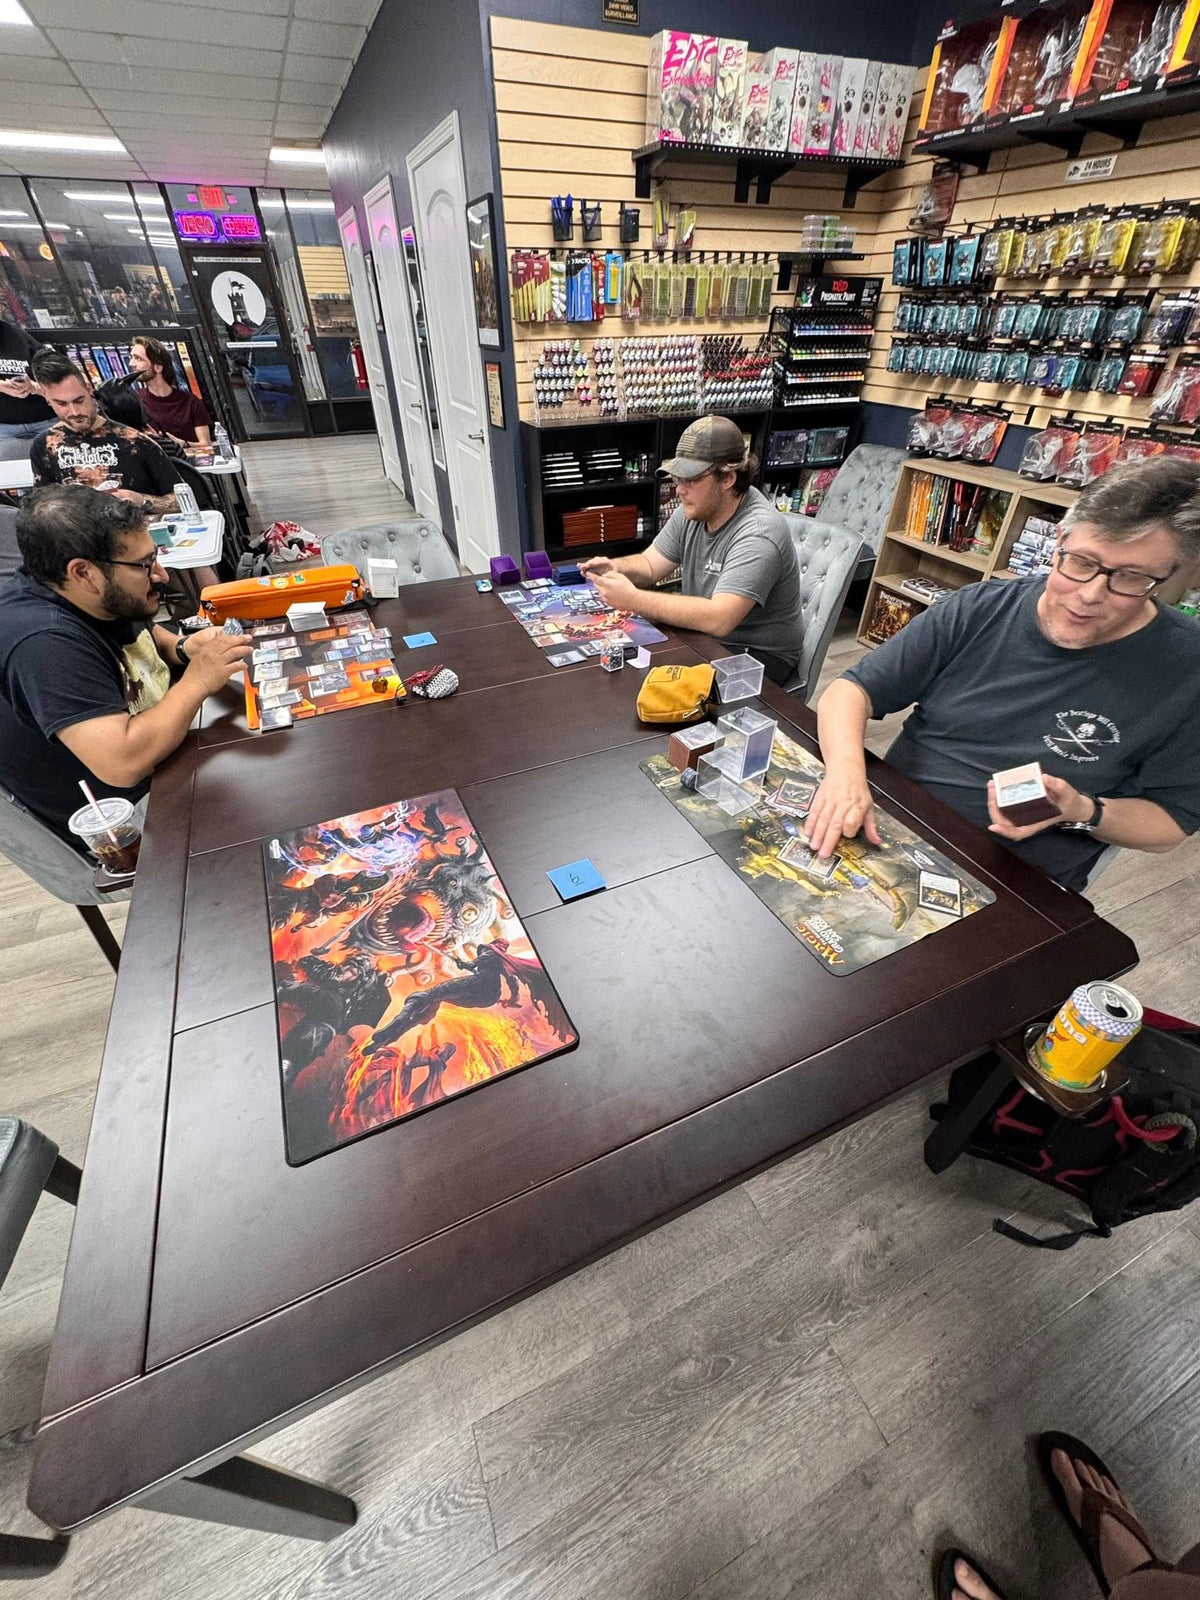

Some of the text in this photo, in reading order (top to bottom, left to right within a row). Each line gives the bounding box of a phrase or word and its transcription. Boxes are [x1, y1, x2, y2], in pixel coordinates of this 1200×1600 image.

[201, 187, 224, 208] EXIT
[820, 291, 842, 302] PRISMATIC
[842, 291, 857, 302] PAINT
[820, 931, 844, 953] GRAND
